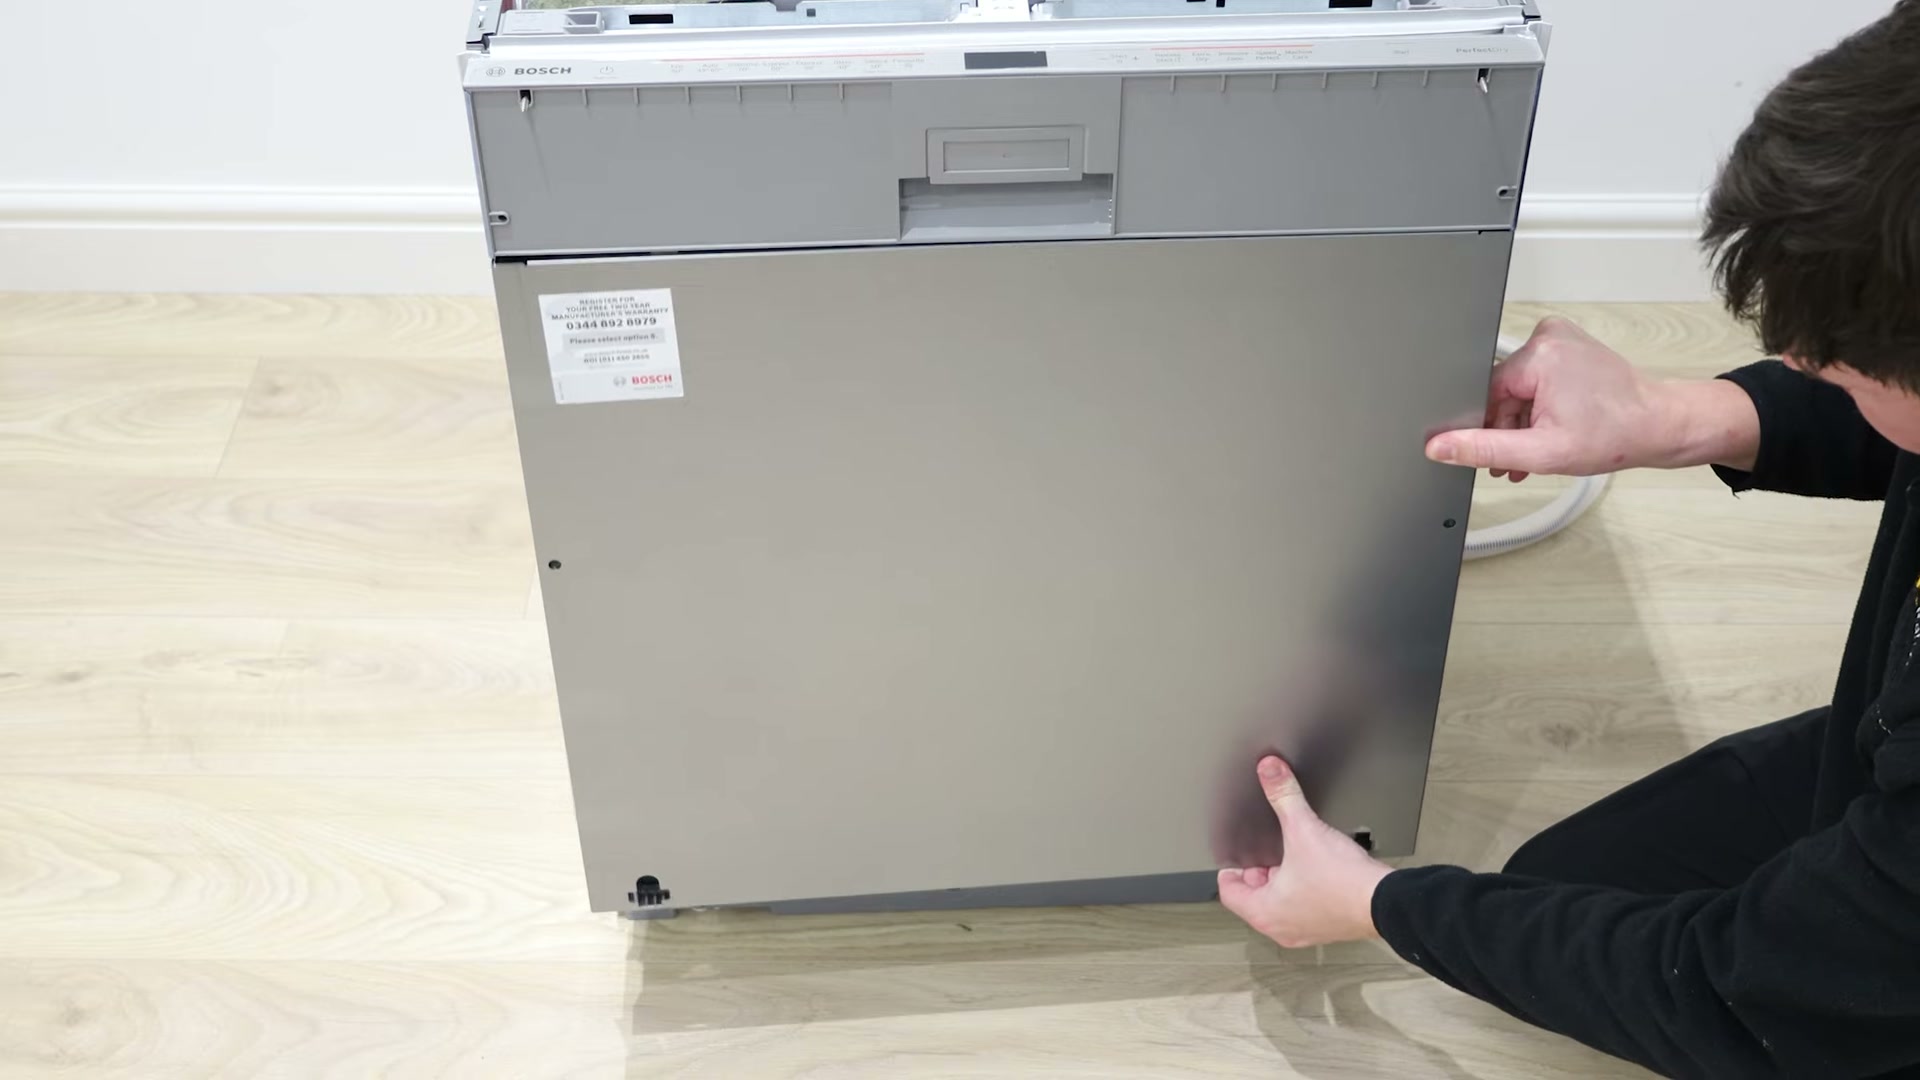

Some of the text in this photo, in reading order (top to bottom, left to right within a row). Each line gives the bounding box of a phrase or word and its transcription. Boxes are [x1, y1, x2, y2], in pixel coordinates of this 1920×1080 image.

[514, 66, 572, 76] BOSCH
[579, 297, 618, 305] REGISTER
[551, 307, 669, 320] MANUFACTURER'S WARRANTY
[566, 305, 587, 313] YOUR
[566, 317, 657, 330] 0344 892 8979
[569, 337, 596, 345] Please
[597, 335, 622, 343] select
[623, 334, 648, 343] option
[631, 374, 673, 385] BOSCH
